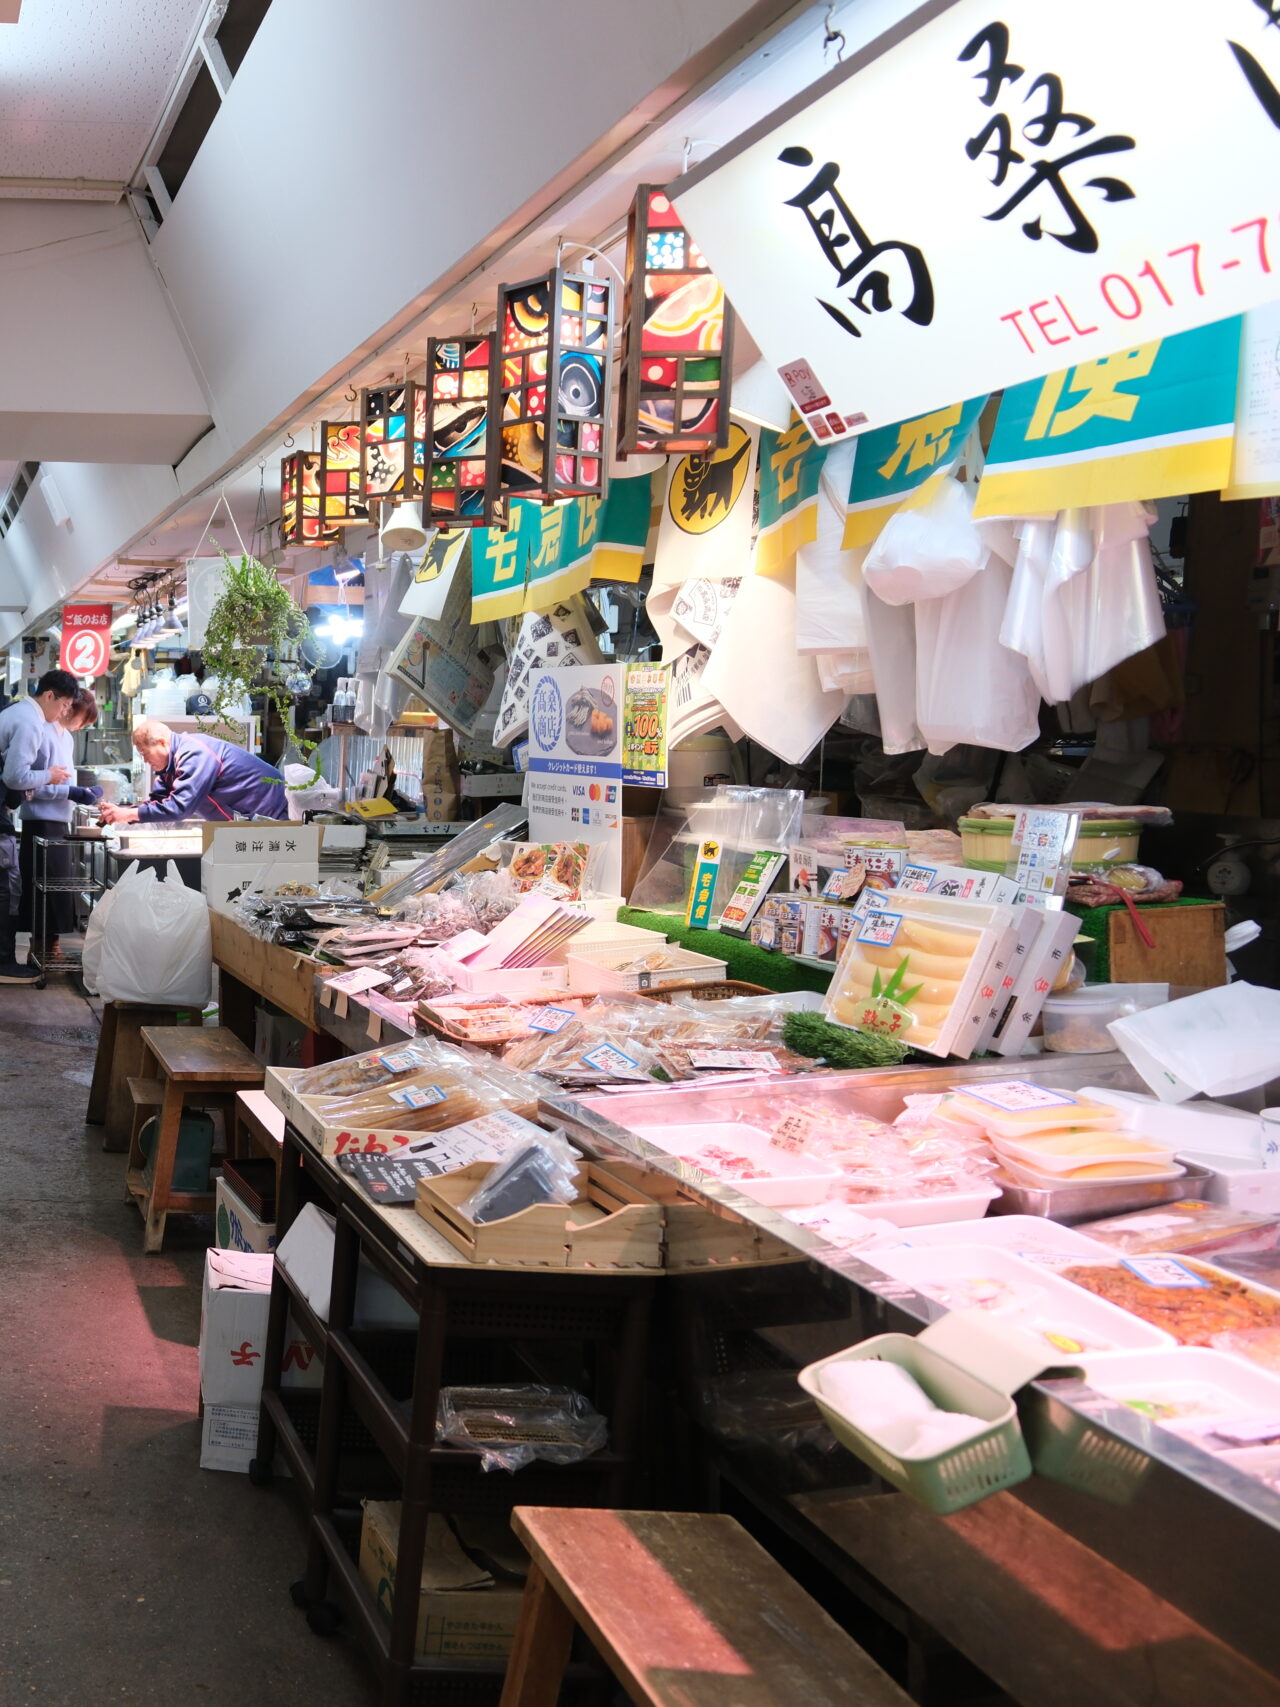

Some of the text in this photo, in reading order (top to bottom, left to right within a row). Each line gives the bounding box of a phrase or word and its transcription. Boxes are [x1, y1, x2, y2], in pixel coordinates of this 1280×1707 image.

[1001, 216, 1272, 355] TEL 017-7
[64, 613, 108, 625] ご飯のお店
[538, 716, 556, 738] 商店
[546, 783, 557, 791] credit
[573, 785, 585, 796] VISA
[695, 873, 713, 919] 宅急便
